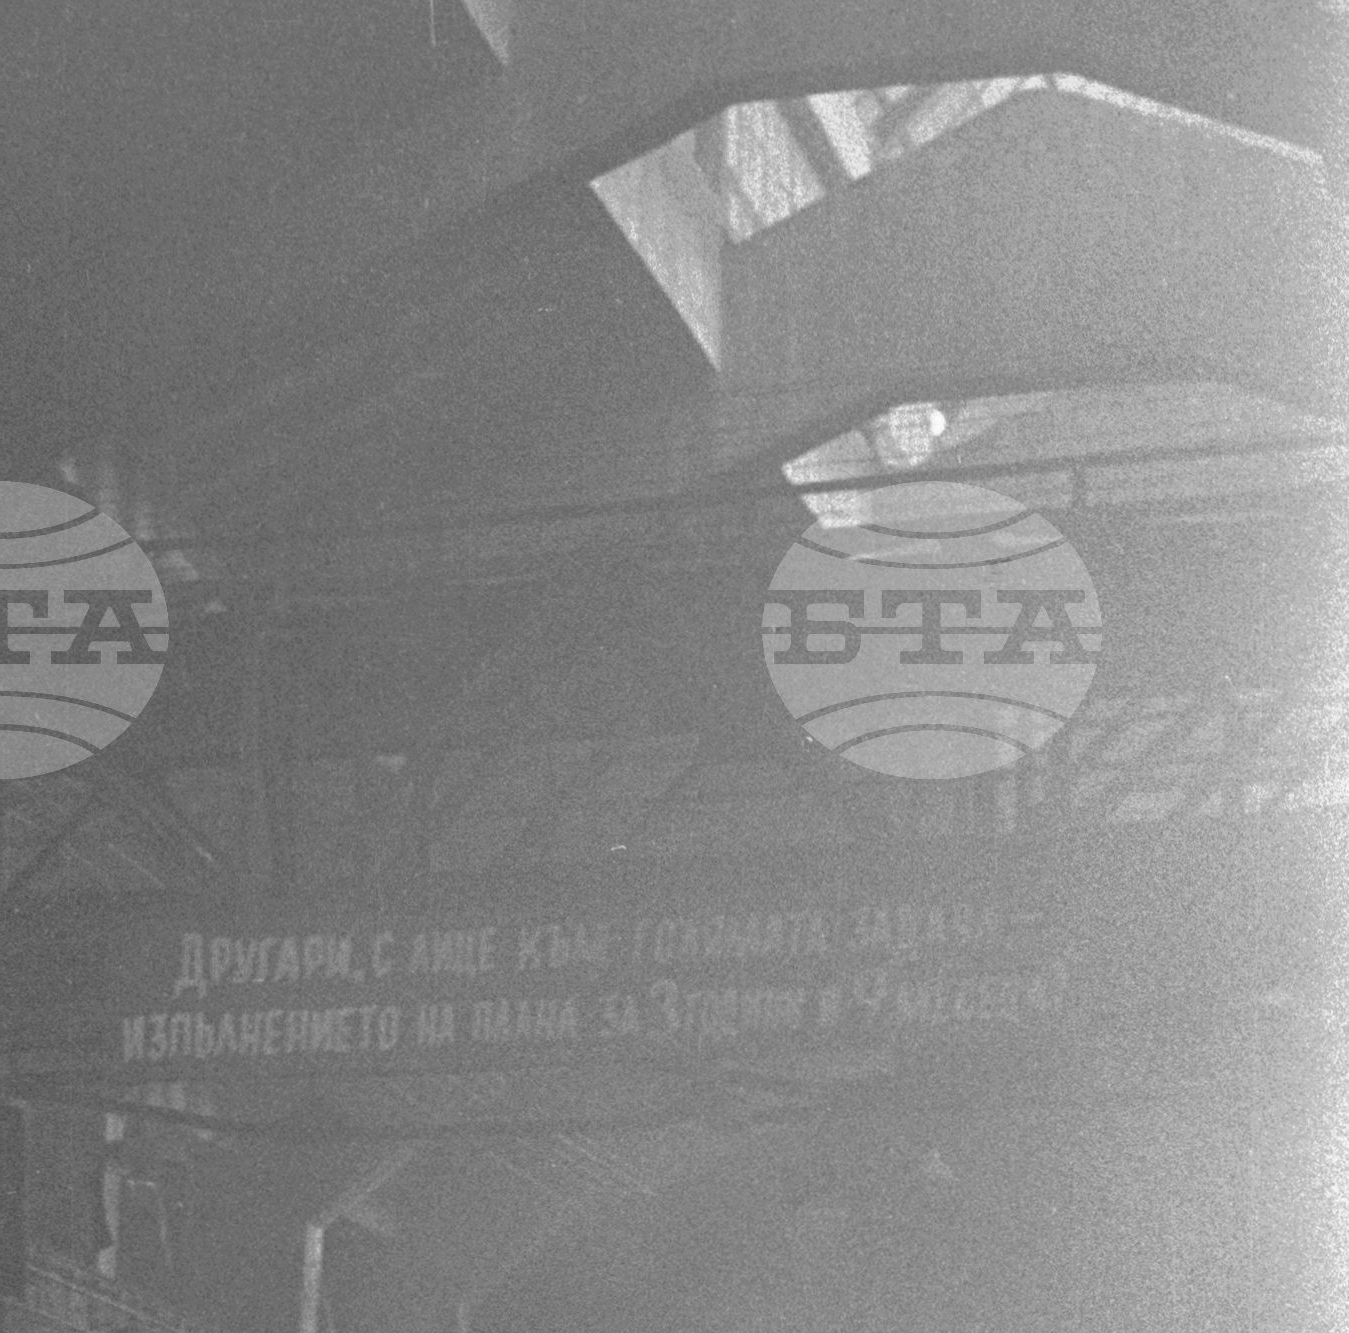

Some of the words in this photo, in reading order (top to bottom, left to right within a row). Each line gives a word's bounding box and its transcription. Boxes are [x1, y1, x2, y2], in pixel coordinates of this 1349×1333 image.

[372, 928, 395, 978] С
[121, 1003, 402, 1064] ИЗПЪЛНЕНИЕТО
[417, 1001, 456, 1048] НА
[472, 993, 580, 1042] ПЛАНА
[596, 991, 641, 1039] ЗА
